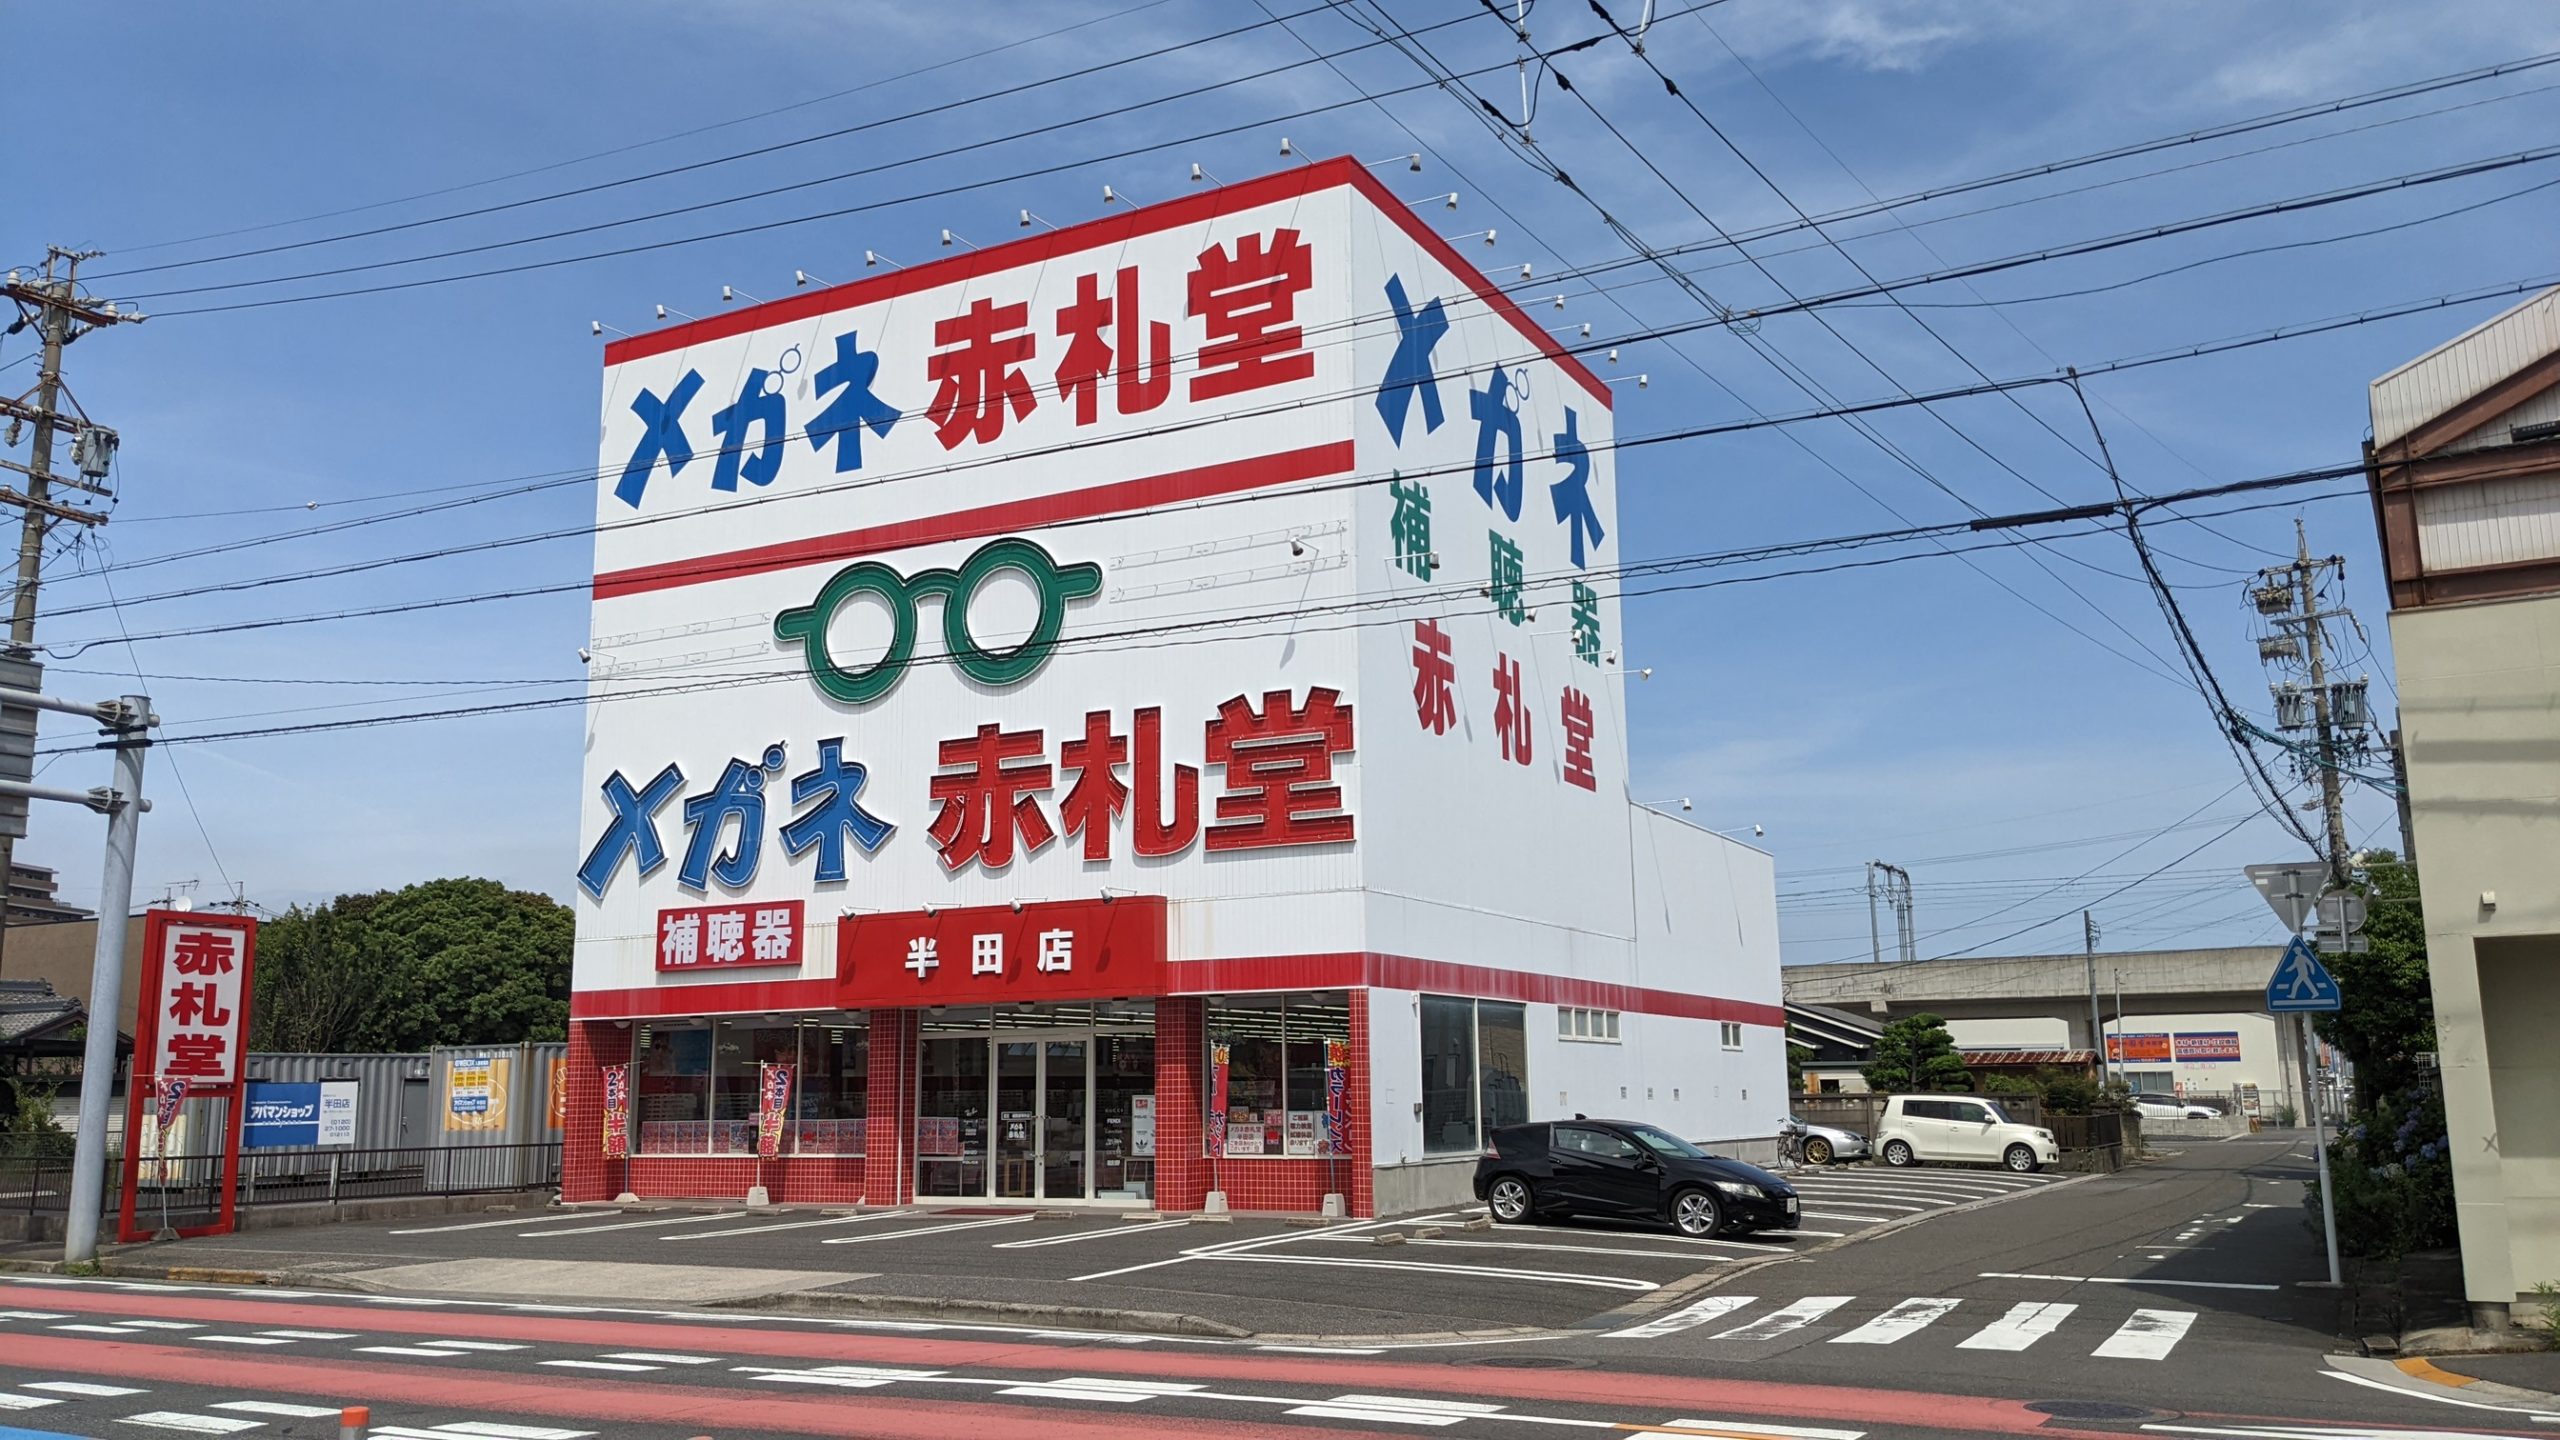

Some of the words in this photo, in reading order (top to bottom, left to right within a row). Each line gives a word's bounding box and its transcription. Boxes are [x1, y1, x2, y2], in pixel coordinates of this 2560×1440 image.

[1376, 272, 1604, 570] メガネ
[1390, 469, 1600, 667] 補聴器
[1412, 618, 1596, 792] 赤札堂
[662, 909, 793, 965] 補聴器
[905, 928, 1073, 978] 半田店
[164, 932, 235, 1076] 赤札堂
[251, 1104, 315, 1119] アパマンショップ
[324, 1099, 350, 1109] 半田店
[607, 1071, 618, 1109] 2本目
[606, 1112, 627, 1155] 半額
